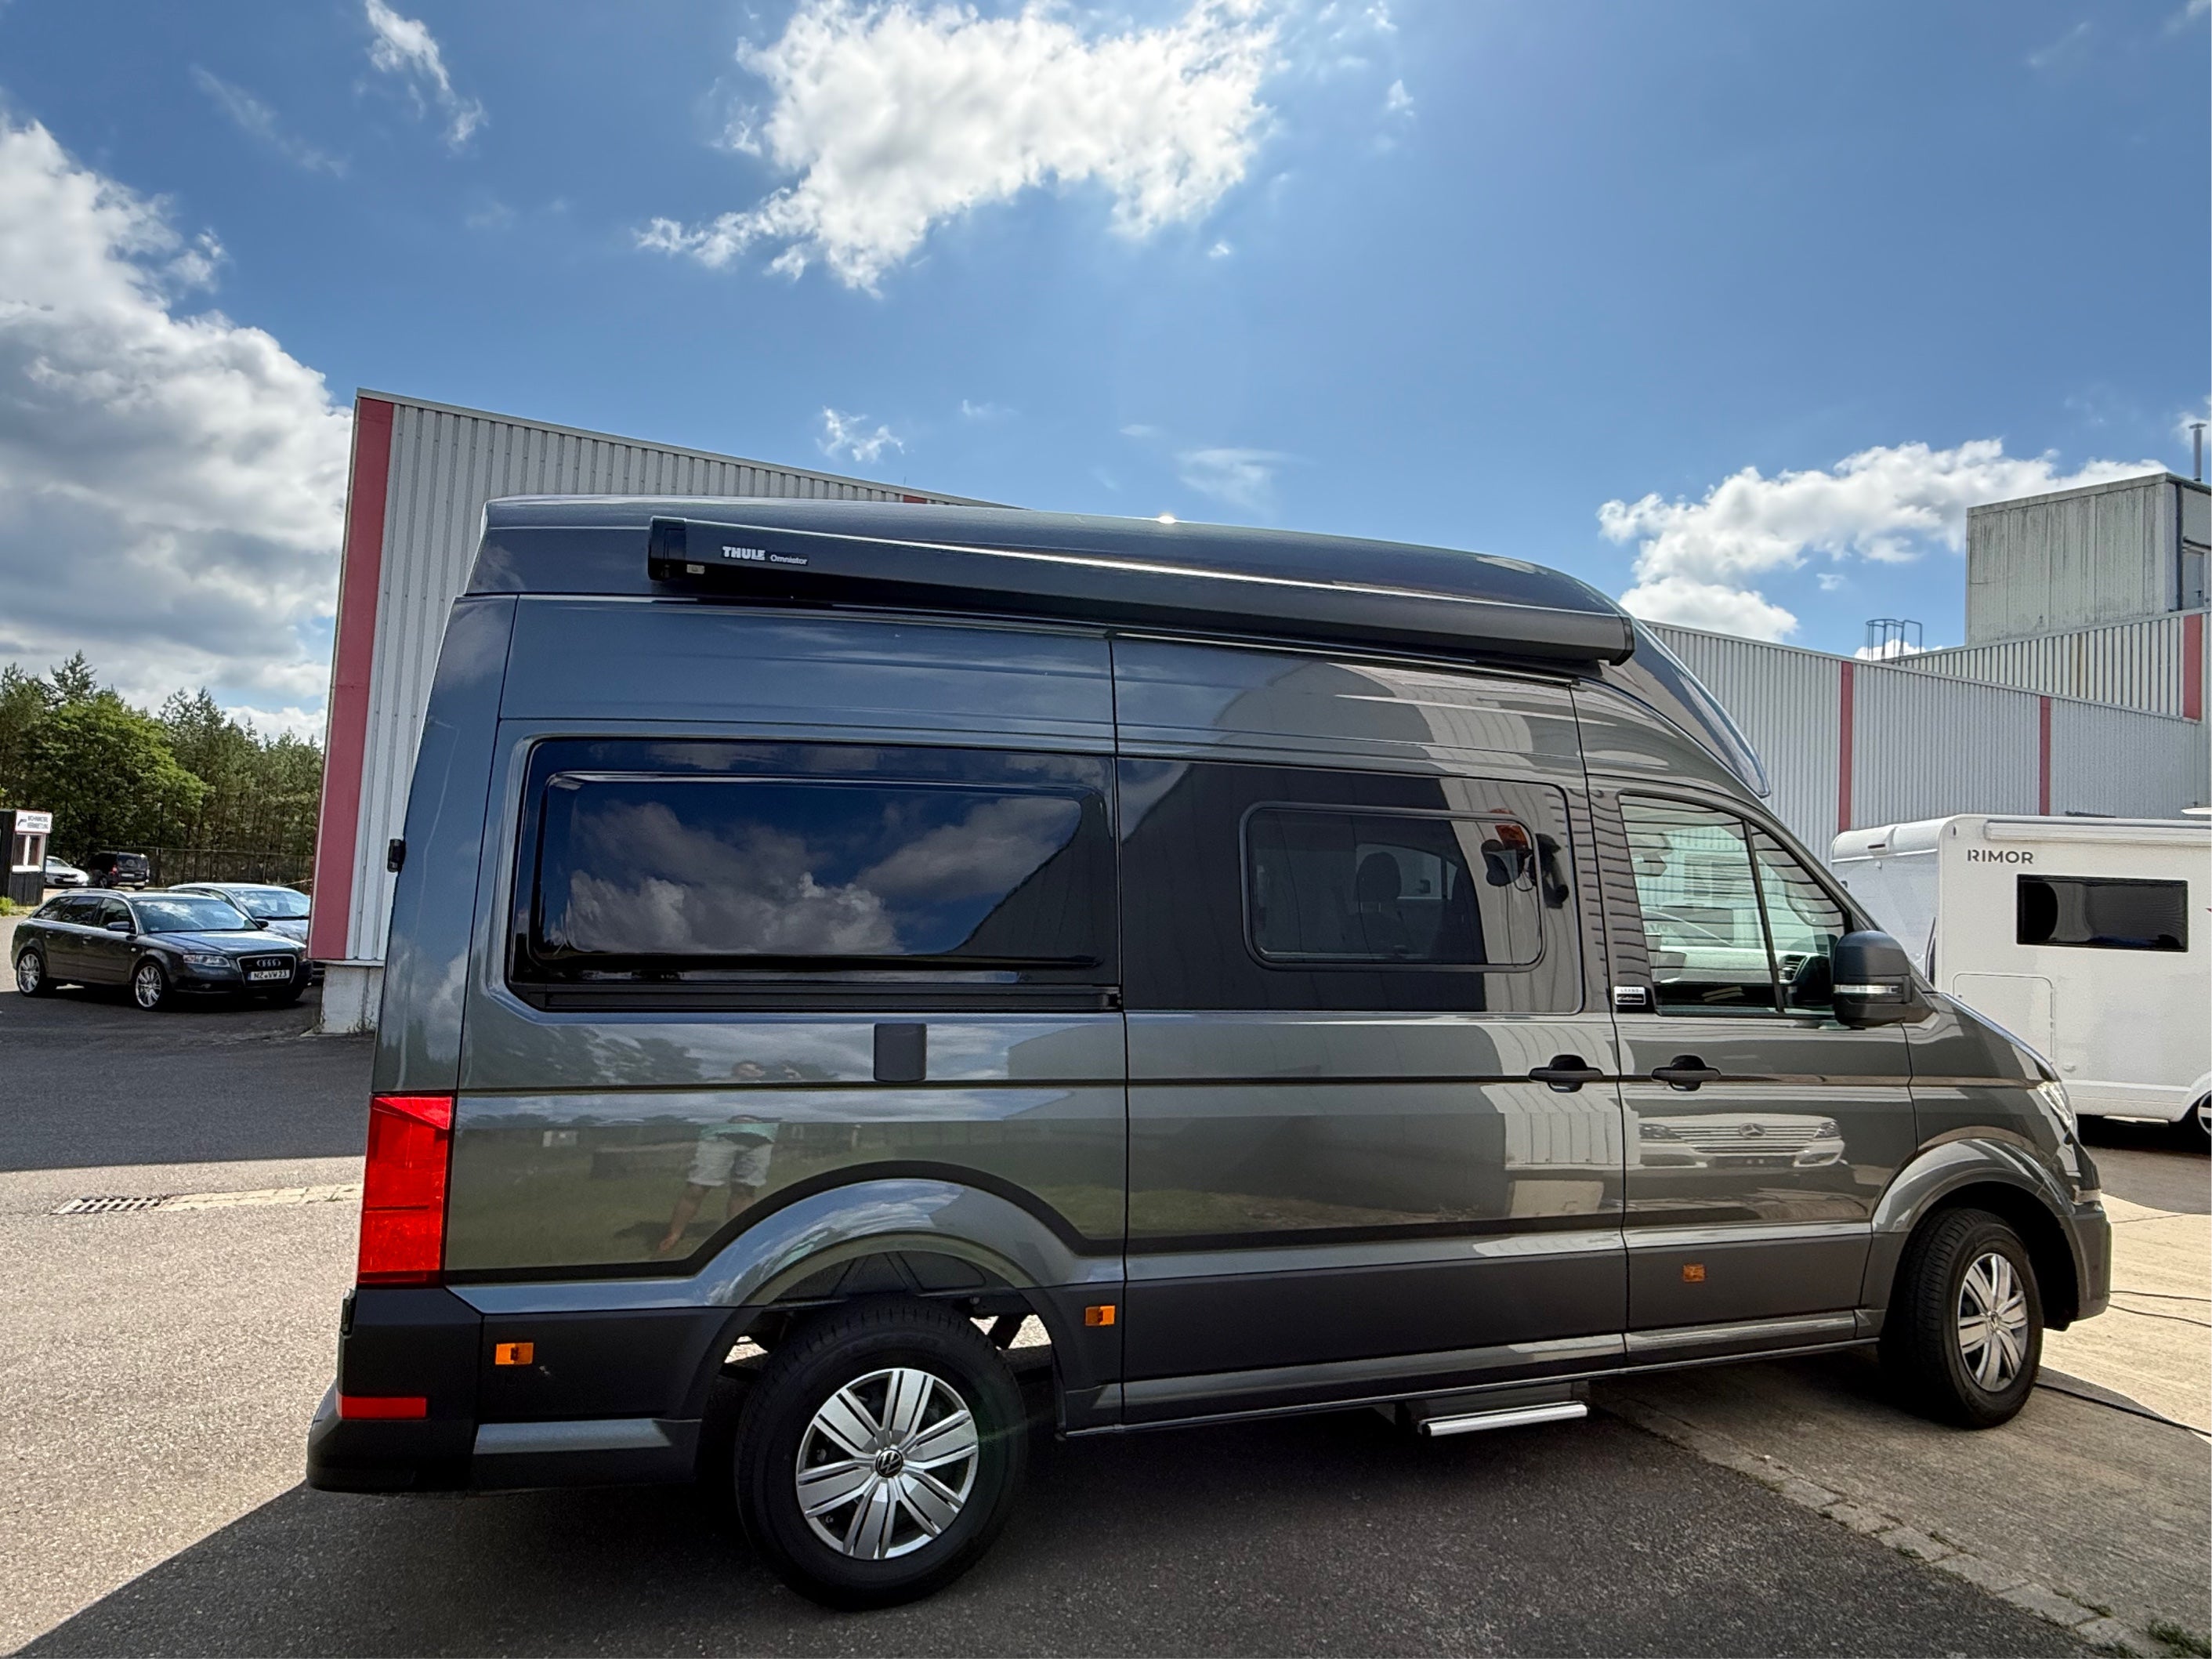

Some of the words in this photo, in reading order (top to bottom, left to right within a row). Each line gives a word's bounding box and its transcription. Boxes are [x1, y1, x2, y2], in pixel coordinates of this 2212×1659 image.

[722, 546, 766, 561] THULE
[770, 554, 808, 565] Omnistor
[1968, 849, 2033, 864] RIMOR
